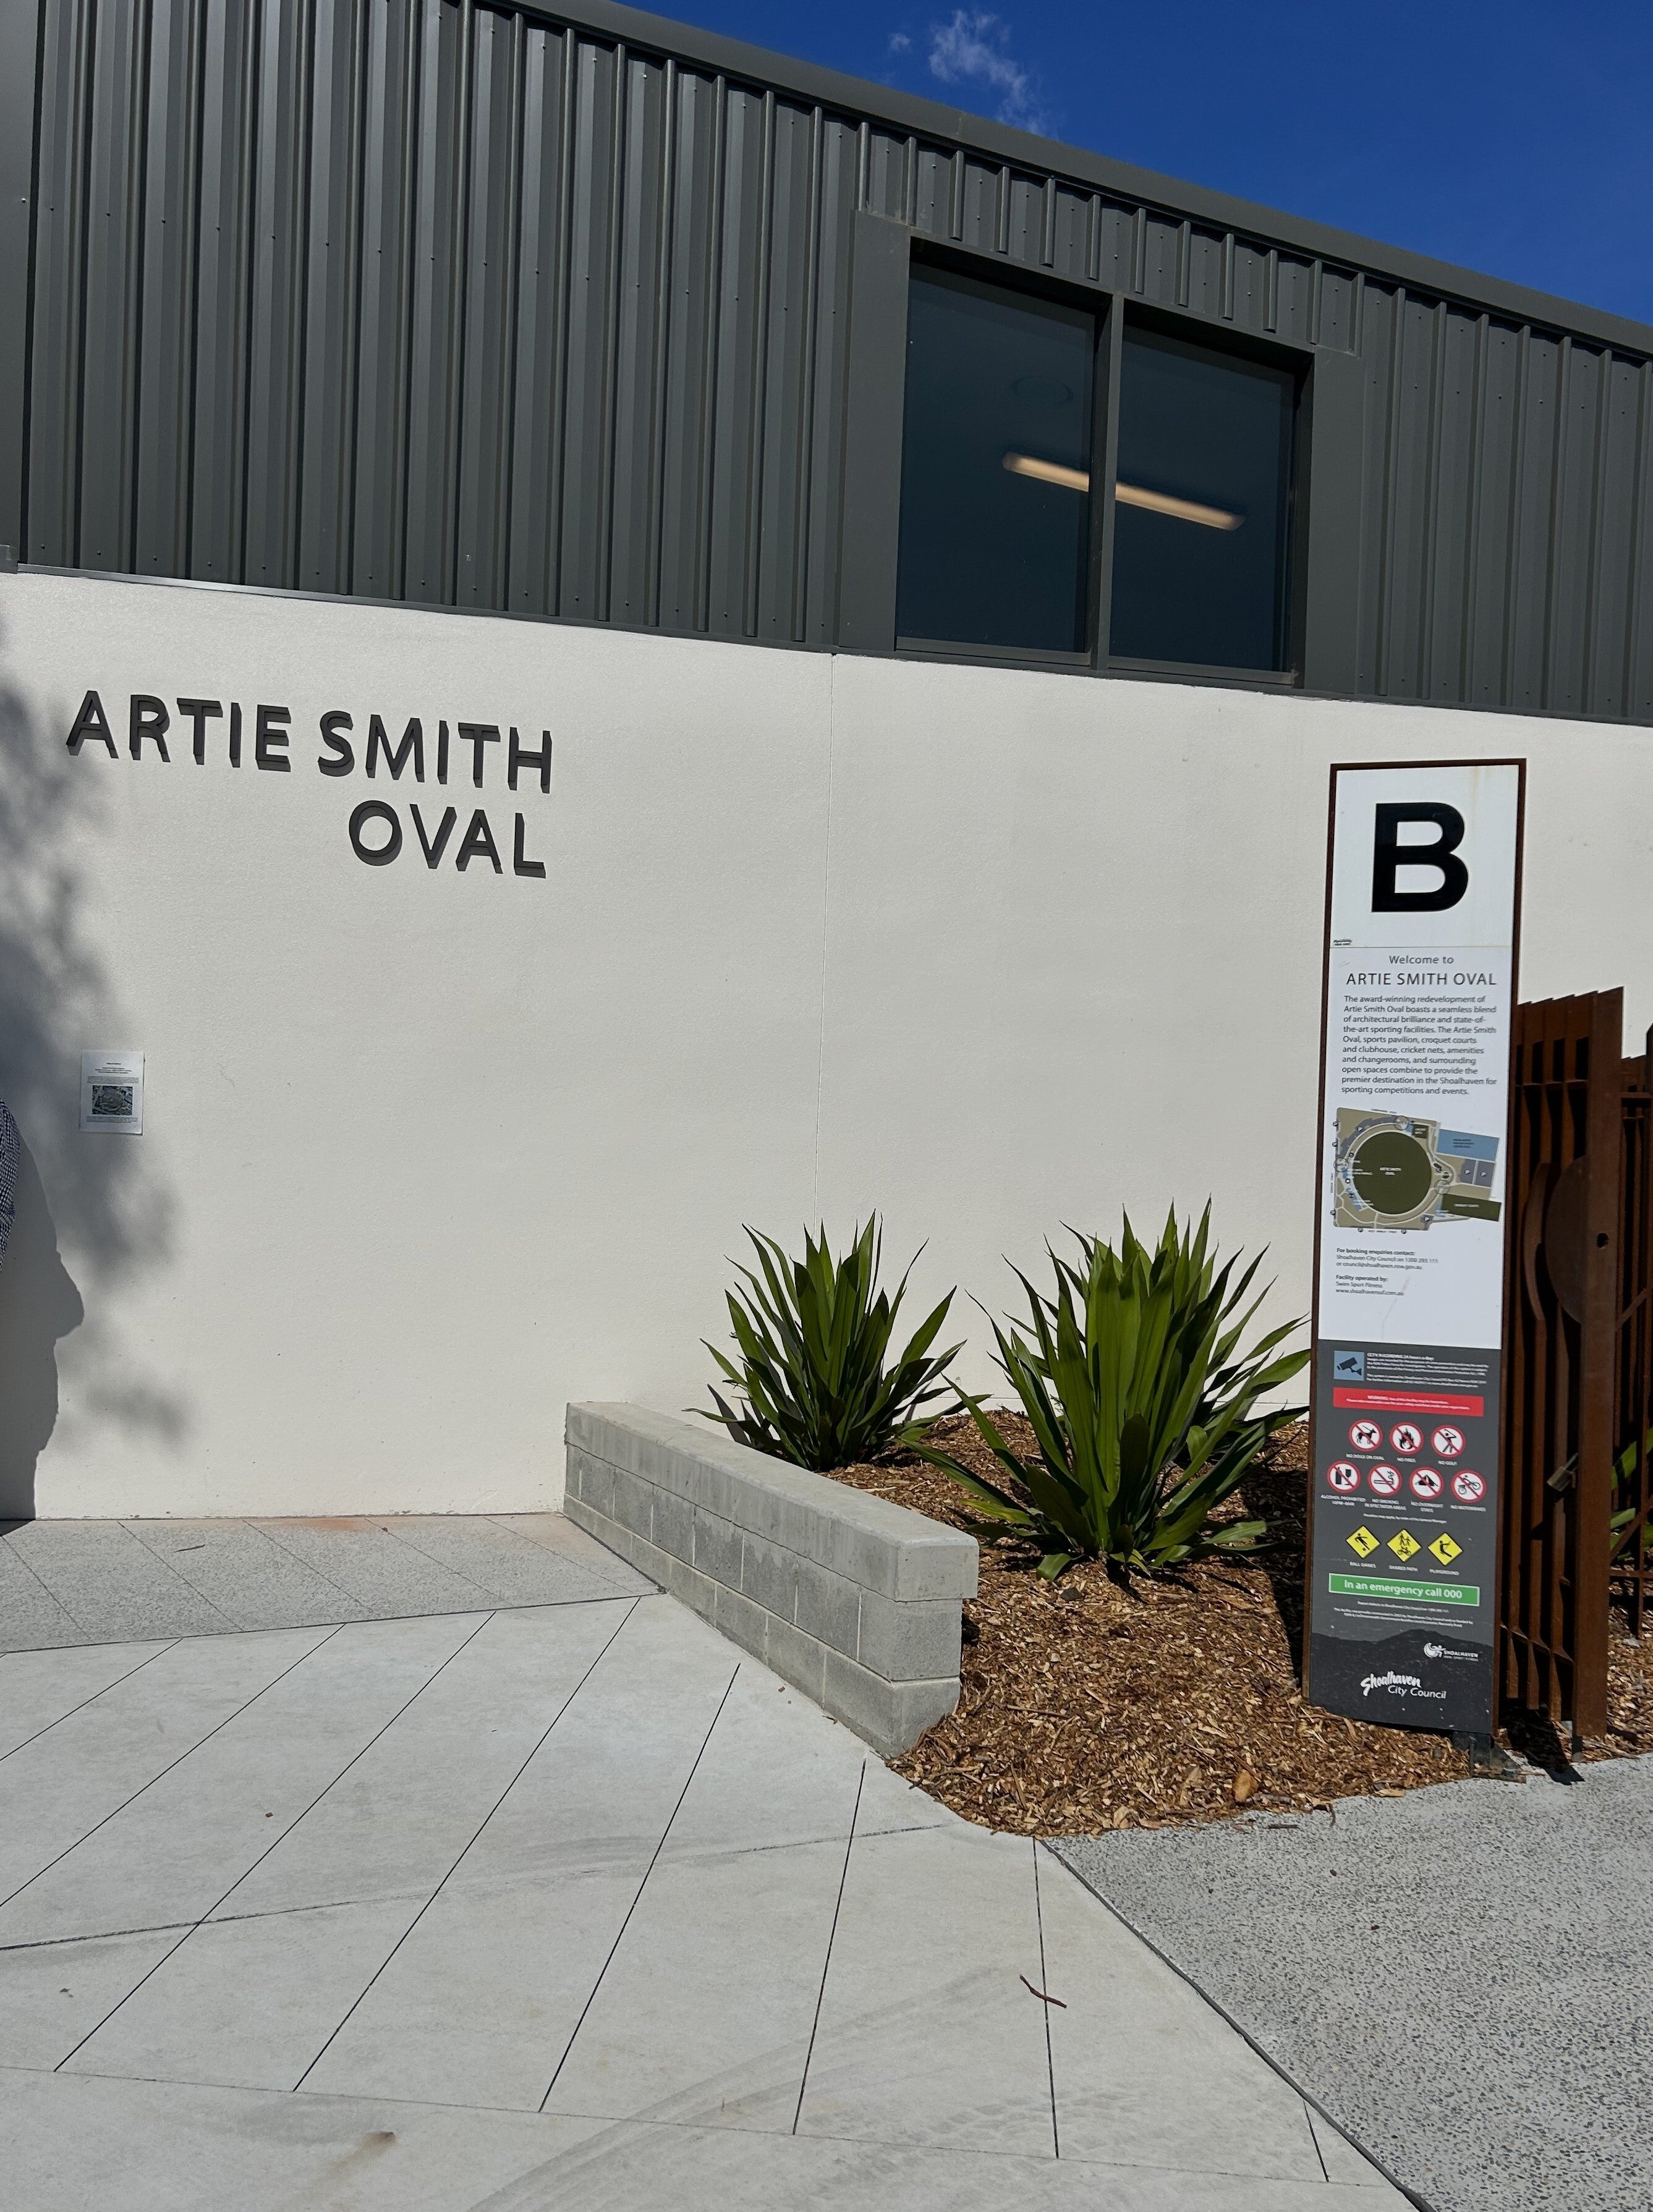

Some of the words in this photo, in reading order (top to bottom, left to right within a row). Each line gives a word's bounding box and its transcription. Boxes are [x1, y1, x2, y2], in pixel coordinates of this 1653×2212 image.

[66, 690, 292, 772] ARTIE
[317, 710, 553, 794] SMITH
[349, 800, 546, 878] OVAL
[1372, 802, 1468, 912] B
[1389, 956, 1439, 964] Welcome
[1443, 956, 1454, 964] to
[1346, 973, 1392, 985] ARTIE
[1397, 973, 1447, 985] SMITH
[1453, 973, 1497, 985] OVAL
[1360, 996, 1415, 1004] award-winning
[1388, 1036, 1419, 1044] pavilion,
[1429, 1057, 1476, 1066] surrounding
[1374, 1087, 1423, 1095] competitions
[1345, 1580, 1354, 1588] In
[1370, 1583, 1424, 1596] emergency
[1425, 1587, 1442, 1596] call
[1443, 1590, 1462, 1599] 000
[1360, 1671, 1422, 1697] Shoalhaven
[1388, 1685, 1408, 1697] City
[1410, 1687, 1447, 1699] Council
